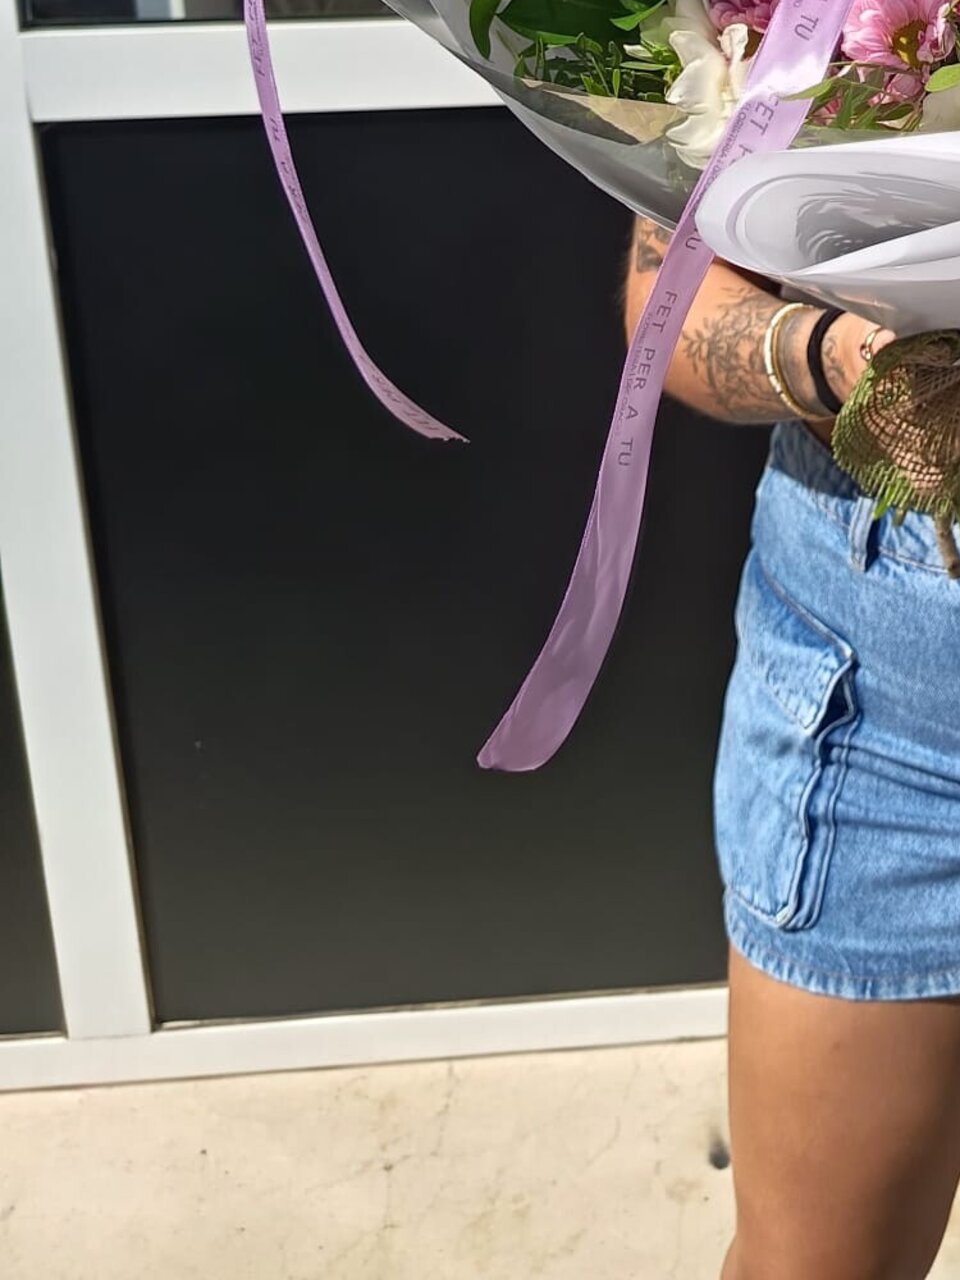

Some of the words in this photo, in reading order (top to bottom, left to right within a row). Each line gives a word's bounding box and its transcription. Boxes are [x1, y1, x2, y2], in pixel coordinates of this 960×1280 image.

[794, 14, 819, 41] TU
[685, 227, 702, 250] U
[651, 290, 678, 334] FET
[633, 348, 656, 390] PER
[625, 405, 639, 420] A
[618, 437, 634, 468] TU
